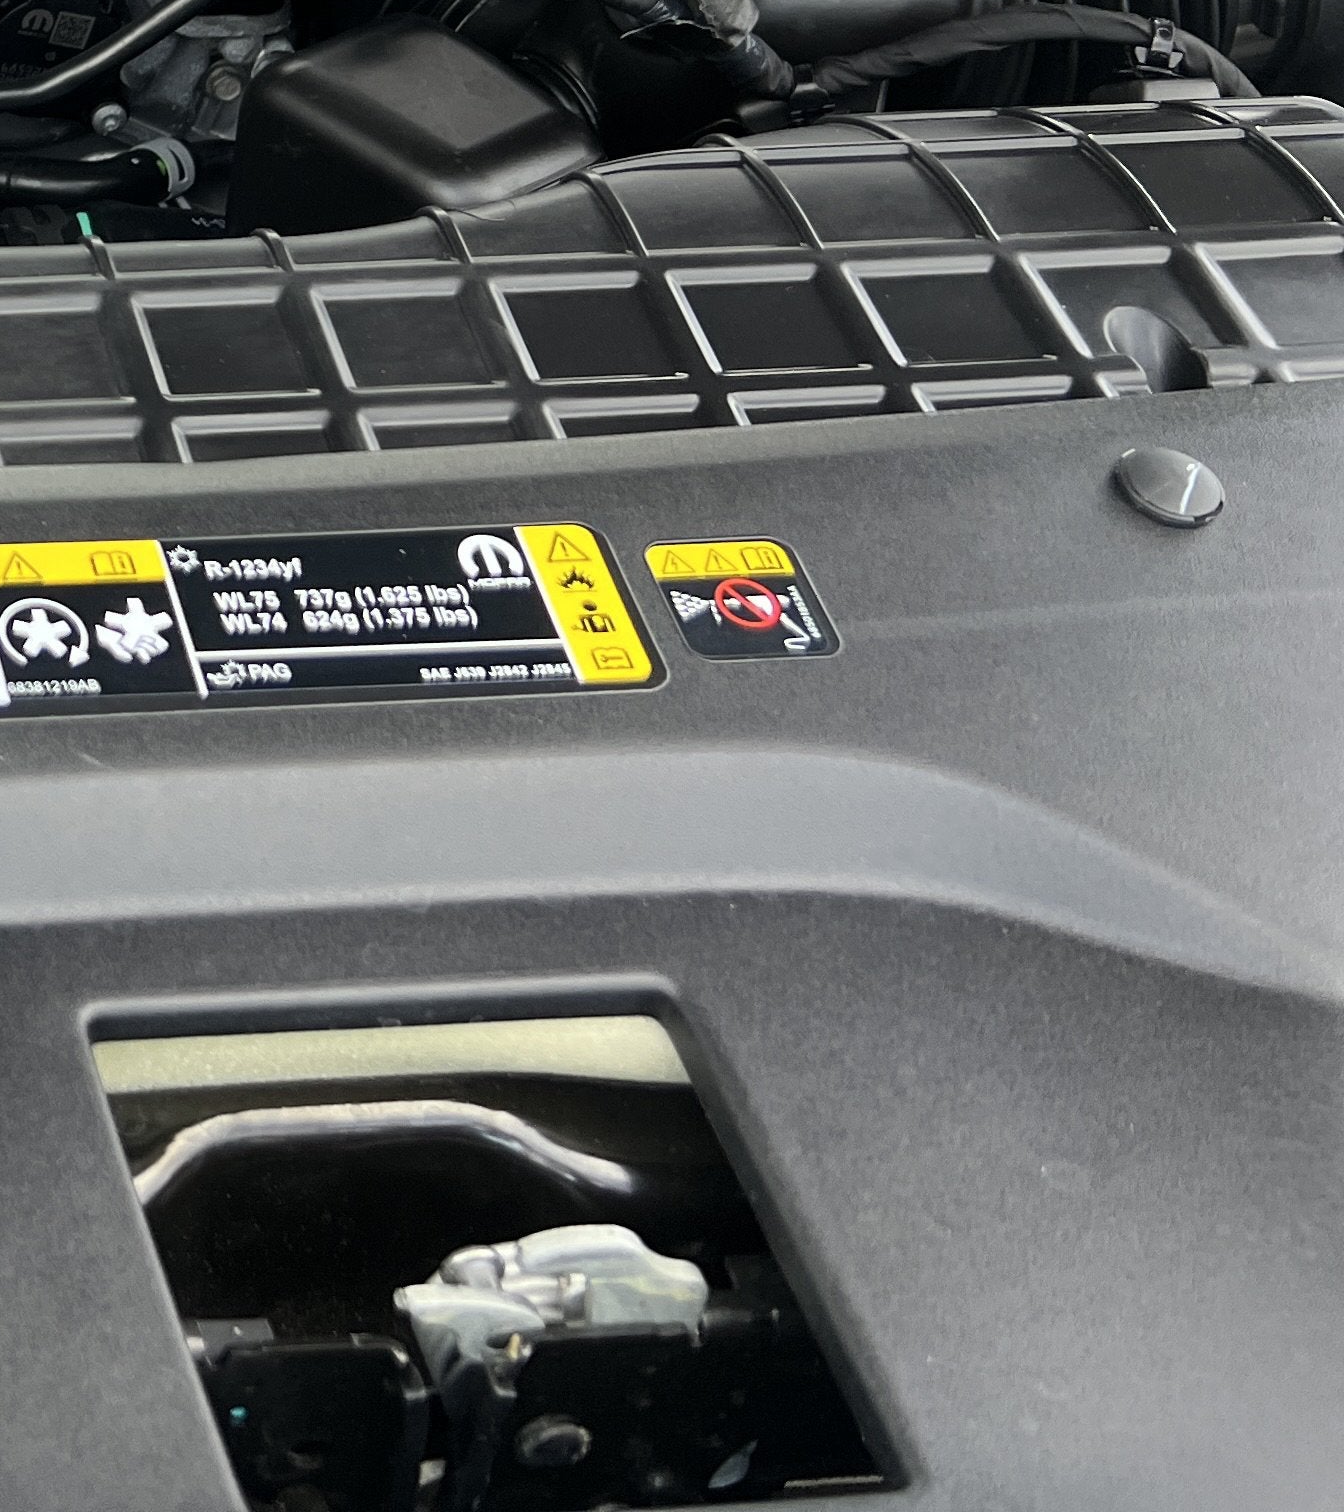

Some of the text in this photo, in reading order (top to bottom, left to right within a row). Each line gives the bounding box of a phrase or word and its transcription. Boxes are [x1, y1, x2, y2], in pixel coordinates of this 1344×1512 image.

[203, 557, 302, 582] R-1234yf
[213, 584, 470, 614] WL75 737g (1.625 lbs)
[220, 605, 479, 636] WL74 624g (1.375 lbs)
[247, 662, 293, 688] PAG
